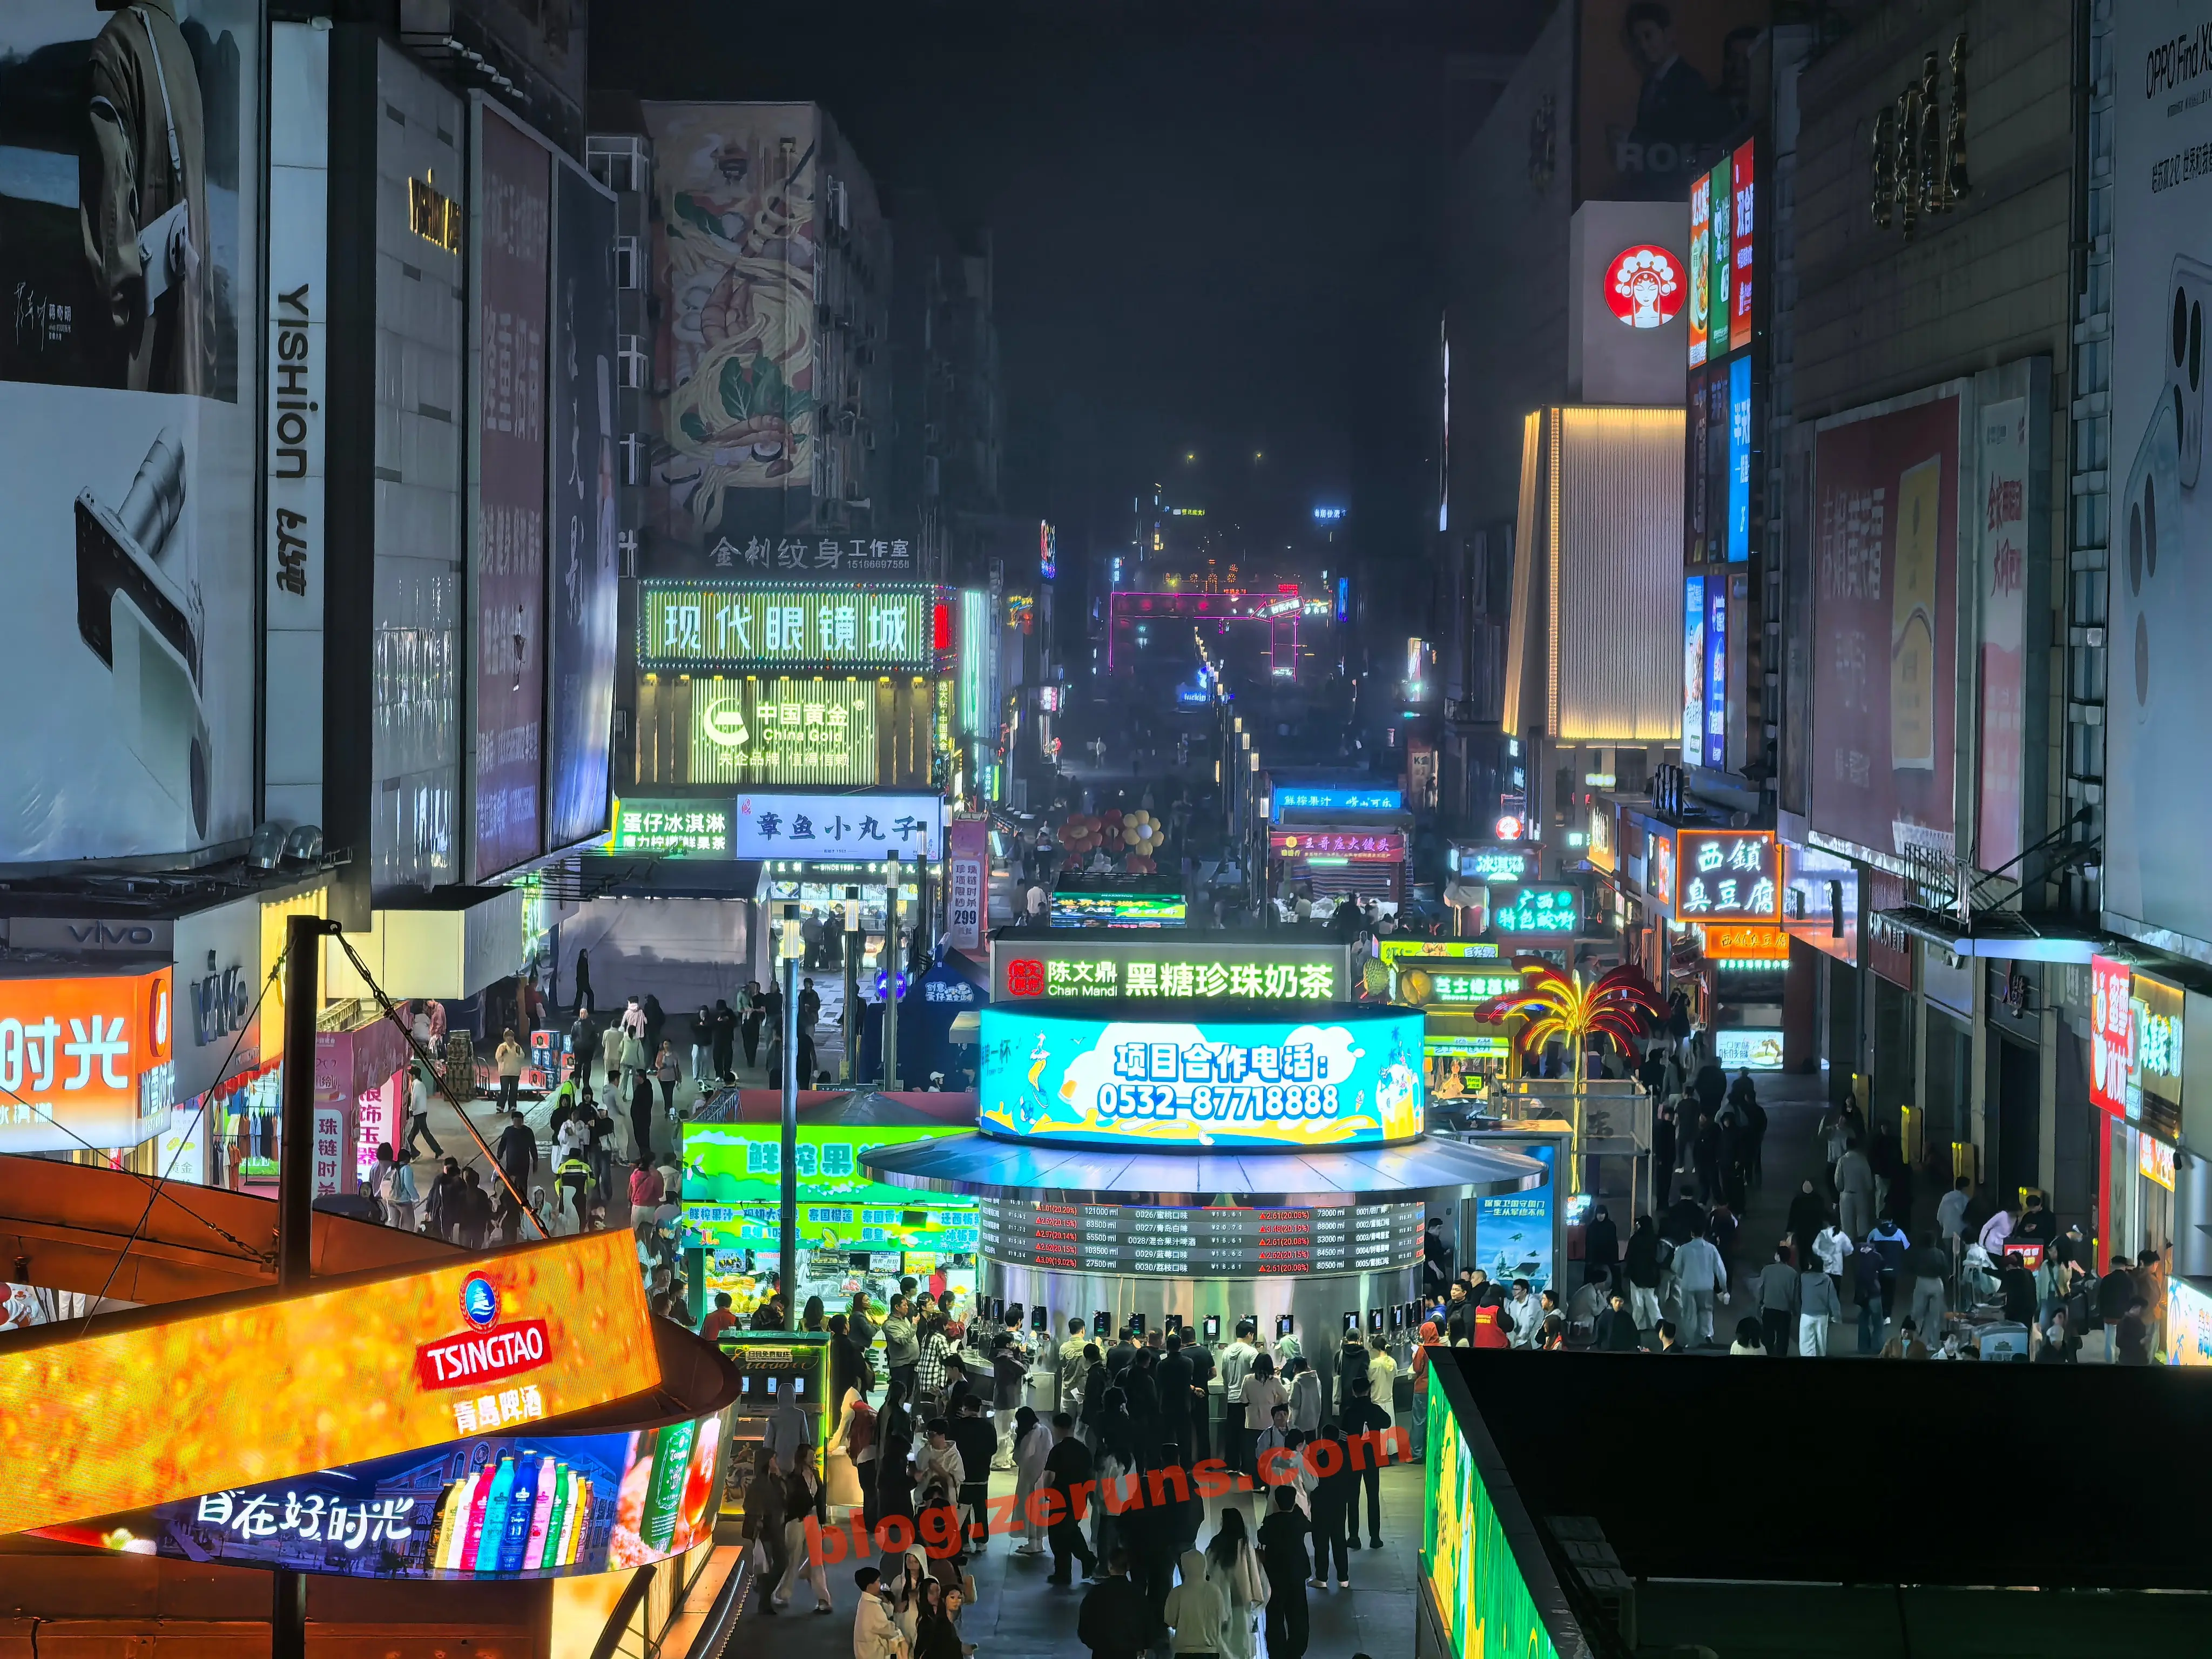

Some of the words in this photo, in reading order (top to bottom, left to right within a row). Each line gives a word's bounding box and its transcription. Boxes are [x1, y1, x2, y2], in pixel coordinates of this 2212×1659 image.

[2146, 39, 2175, 99] OPPO
[2177, 25, 2199, 85] Find
[665, 605, 907, 651] 现代眼镜城
[756, 703, 849, 726] 中国黄金
[763, 729, 805, 742] China
[809, 729, 844, 743] Gold
[719, 752, 780, 767] 央企品牌
[789, 752, 850, 767] 值得信赖
[1346, 797, 1392, 808] 崂山可乐
[623, 813, 726, 833] 蛋仔冰淇淋
[757, 812, 917, 841] 章鱼小丸子
[1305, 836, 1390, 852] 王哥庄大馒头
[820, 864, 839, 872] SINCE
[1476, 855, 1524, 873] 冰淇淋
[1517, 889, 1554, 911] 广西
[1683, 878, 1775, 913] 臭豆腐
[954, 910, 977, 925] 299
[69, 921, 153, 944] vivo
[1048, 961, 1117, 983] 陈文鼎
[1125, 962, 1334, 998] 黑糖珍珠奶茶
[190, 949, 249, 1047] vivo
[1048, 984, 1078, 997] Chan
[1082, 984, 1118, 997] Mandi
[0, 1014, 129, 1092] 时光
[1097, 1083, 1339, 1120] 0532-87718888
[747, 1142, 886, 1176] 鲜榨果
[689, 1208, 733, 1222] 鲜榨果汁
[808, 1208, 853, 1223] 泰国榴莲
[1041, 1205, 1077, 1215] 1.01(20.20%)
[1085, 1207, 1108, 1216] 121000
[1110, 1208, 1118, 1216] ml
[862, 1227, 884, 1242] 椰皇
[1087, 1220, 1106, 1229] 83500
[1108, 1220, 1116, 1229] ml
[1337, 1222, 1345, 1230] ml
[1087, 1233, 1106, 1242] 55500
[1108, 1233, 1116, 1242] ml
[1337, 1235, 1345, 1243] ml
[1085, 1246, 1108, 1255] 103500
[1110, 1247, 1118, 1255] ml
[1337, 1247, 1345, 1256] ml
[1086, 1259, 1106, 1268] 27500
[1108, 1260, 1116, 1268] ml
[1337, 1260, 1344, 1269] ml
[427, 1327, 543, 1381] TSINGTAO
[453, 1385, 542, 1434] 青岛啤酒
